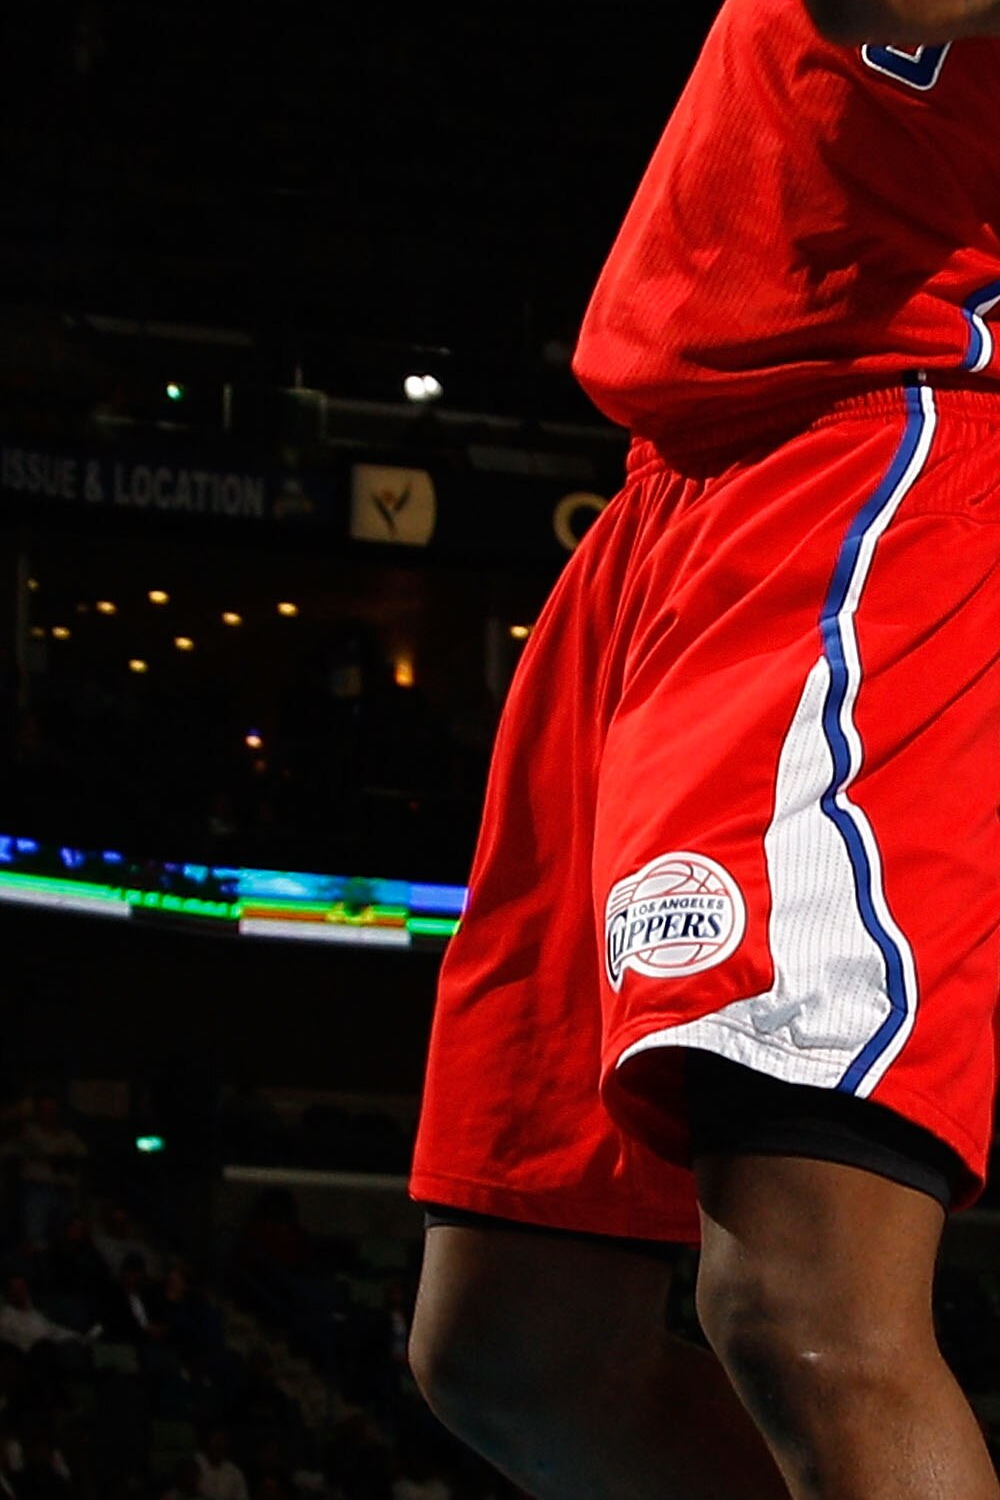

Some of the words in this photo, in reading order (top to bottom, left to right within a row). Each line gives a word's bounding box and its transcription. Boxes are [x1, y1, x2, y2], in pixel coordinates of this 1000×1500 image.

[1, 447, 78, 501] ISSUE
[83, 459, 105, 505] &
[113, 461, 266, 519] LOCATION
[632, 902, 656, 917] LOS
[658, 897, 725, 912] ANGELES
[608, 908, 723, 982] CLIPPERS
